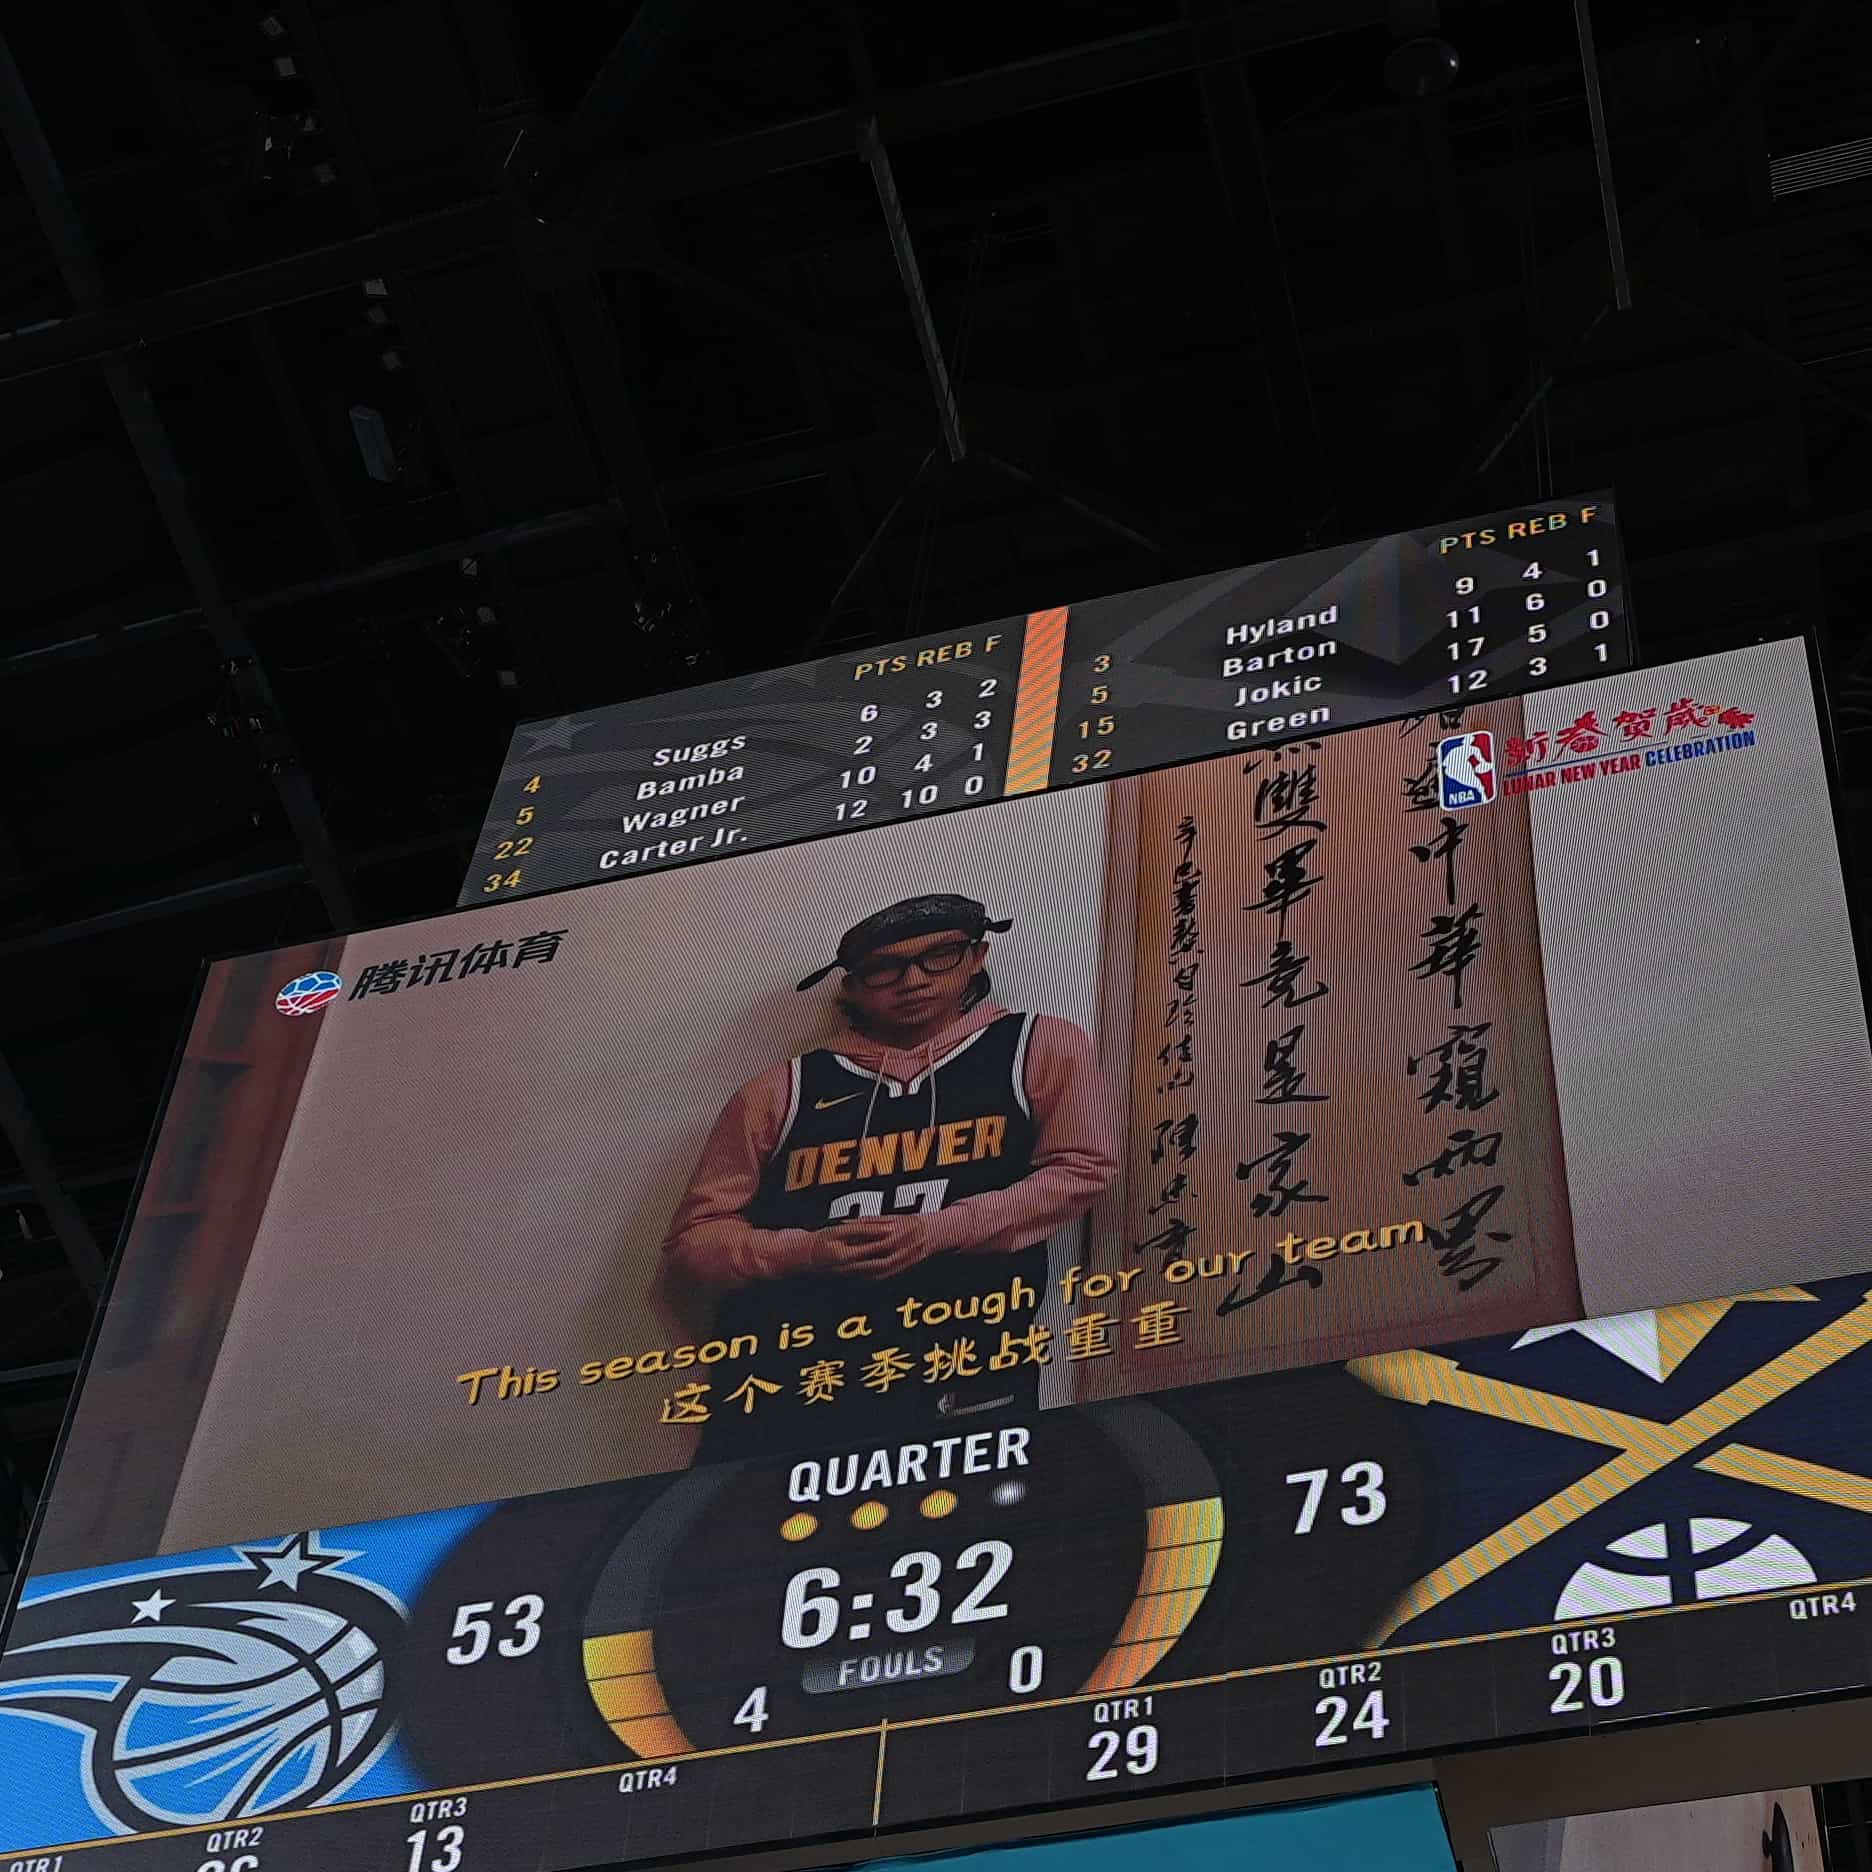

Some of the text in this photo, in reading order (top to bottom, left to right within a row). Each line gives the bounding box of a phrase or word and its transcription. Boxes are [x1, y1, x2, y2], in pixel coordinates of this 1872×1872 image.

[1439, 513, 1568, 555] PTS REB
[854, 641, 973, 680] PTS REB
[1091, 605, 1482, 705] 5 Barton 11
[1094, 577, 1474, 674] 3 Hyland 9
[1072, 670, 1488, 774] 32 Green 12
[1078, 637, 1486, 740] 15 Jokic 17
[516, 735, 873, 827] 5 Bamba 2
[523, 704, 878, 795] 4 Suggs 6
[1503, 729, 1756, 798] LUNAR NEW YEAR CELEBRATION
[494, 766, 877, 861] 22 Wagner 10
[1448, 790, 1475, 806] NBA
[483, 799, 868, 893] 34 Carter Jr. 12
[348, 929, 569, 1001] 腾讯体育
[783, 1114, 1008, 1193] DENVER
[456, 1218, 1426, 1407] This season is a tough for our team
[657, 1300, 1190, 1430] 这个赛季挑战重重
[787, 1426, 1031, 1504] QUARTER
[446, 1458, 1388, 1667] 53 6:32 73
[1551, 1625, 1617, 1657] QTR3
[1789, 1589, 1858, 1621] QTR4
[734, 1644, 1044, 1733] 4 FOULS 0
[1092, 1695, 1154, 1726] QTR1
[1318, 1659, 1383, 1691] QTR2
[1547, 1655, 1626, 1715] 20
[1085, 1725, 1160, 1783] 29
[1313, 1688, 1391, 1749] 24
[408, 1795, 469, 1824] QTR3
[618, 1764, 678, 1794] QTR4
[205, 1826, 264, 1855] QTR2
